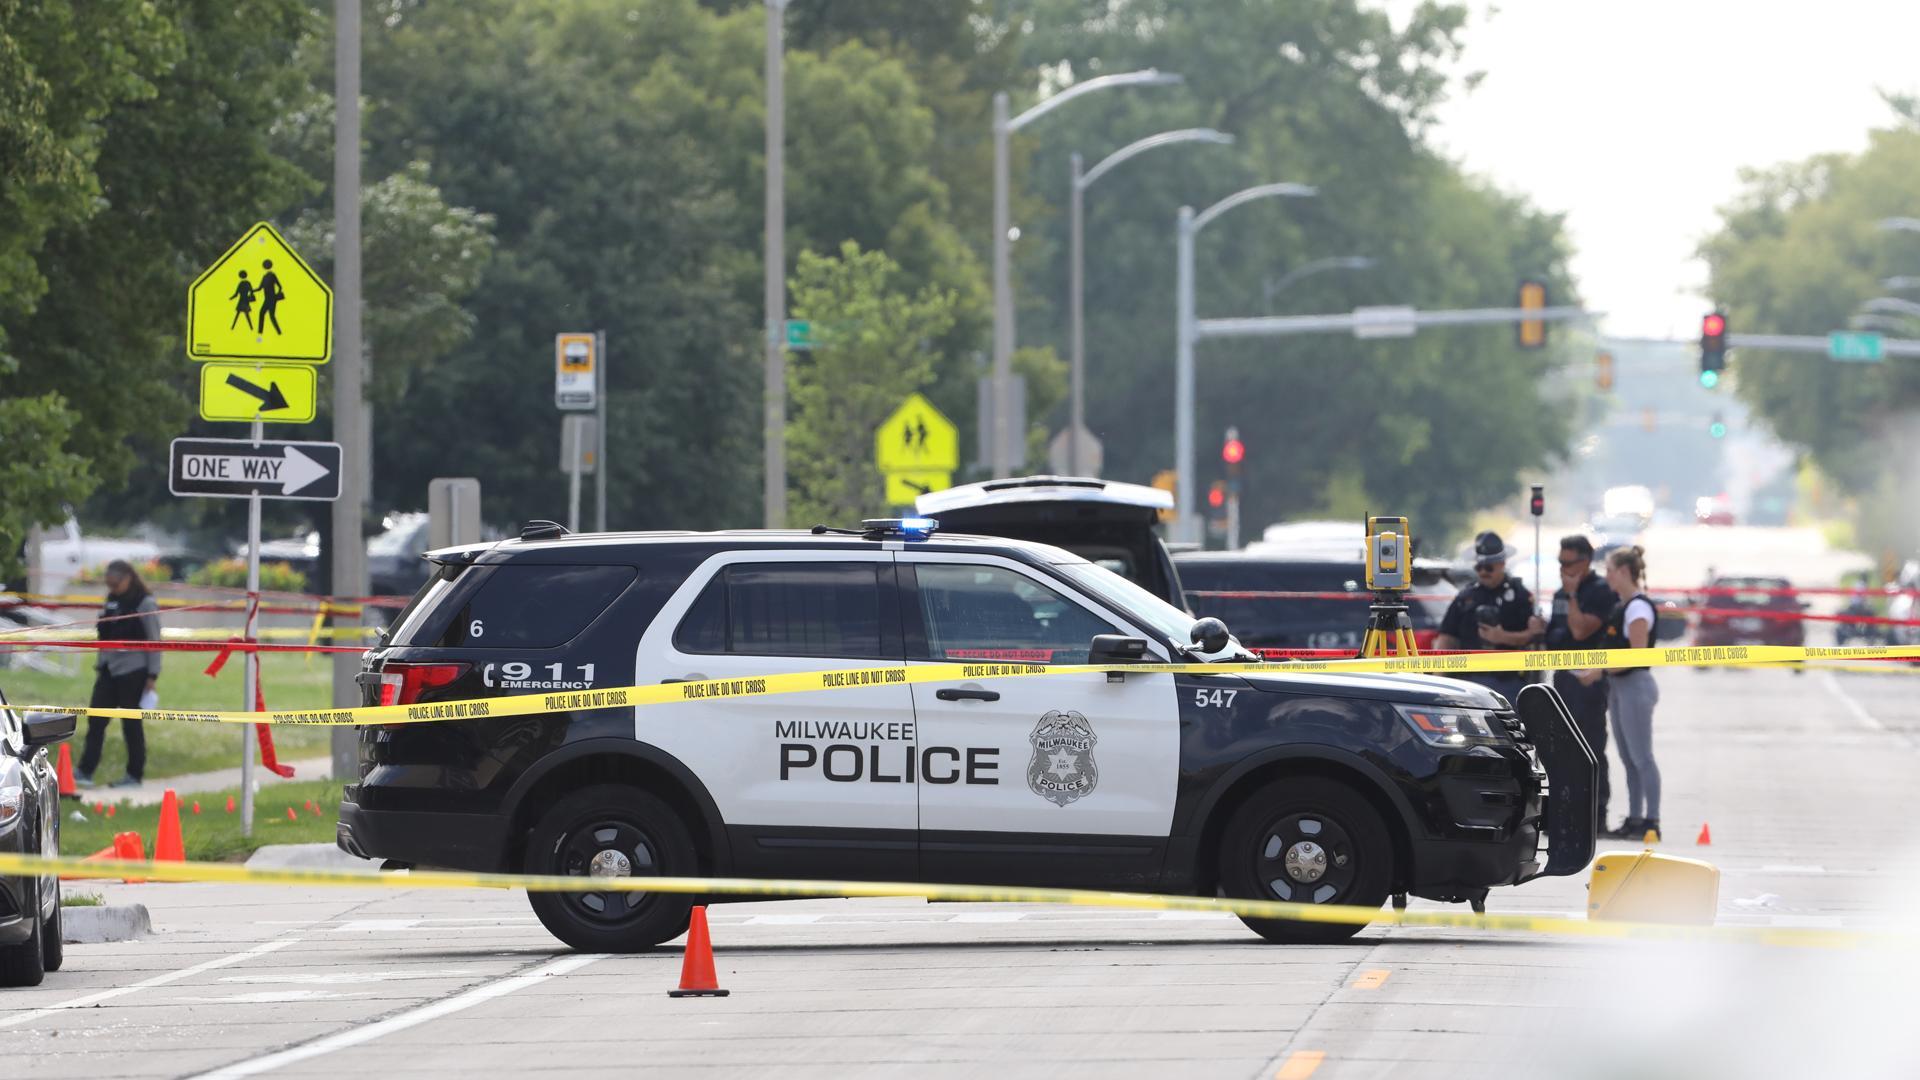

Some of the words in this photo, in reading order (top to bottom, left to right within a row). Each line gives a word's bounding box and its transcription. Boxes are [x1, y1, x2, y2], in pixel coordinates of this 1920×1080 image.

[187, 457, 230, 478] ONE
[242, 459, 282, 480] WAY
[470, 619, 484, 638] 6
[501, 662, 595, 682] 911
[823, 672, 845, 687] POLICE
[846, 672, 860, 686] LINE
[860, 671, 870, 685] DO
[871, 670, 884, 684] NOT
[885, 669, 906, 683] CROSS
[963, 665, 985, 677] POLICE
[986, 664, 1000, 676] LINE
[1001, 664, 1010, 675] DO
[1011, 664, 1024, 675] NOT
[501, 681, 593, 689] EMERGENCY
[683, 684, 705, 698] POLICE
[706, 683, 720, 697] LINE
[720, 682, 730, 696] DO
[731, 681, 743, 695] NOT
[745, 679, 766, 694] CROSS
[545, 695, 567, 710] POLICE
[567, 694, 582, 708] LINE
[582, 693, 592, 707] DO
[592, 692, 605, 706] NOT
[606, 691, 627, 705] CROSS
[1195, 688, 1238, 708] 547
[273, 714, 295, 724] POLICE
[295, 713, 310, 724] LINE
[310, 713, 319, 724] DO
[319, 713, 333, 723] NOT
[333, 711, 354, 723] CROSS
[408, 706, 431, 719] POLICE
[430, 705, 445, 718] LINE
[445, 704, 454, 718] DO
[455, 703, 468, 717] NOT
[469, 702, 490, 716] CROSS
[775, 720, 914, 741] MILWAUKEE
[1038, 738, 1089, 750] MILWAUKEE
[780, 743, 1000, 785] POLICE
[1040, 778, 1084, 791] POLICE
